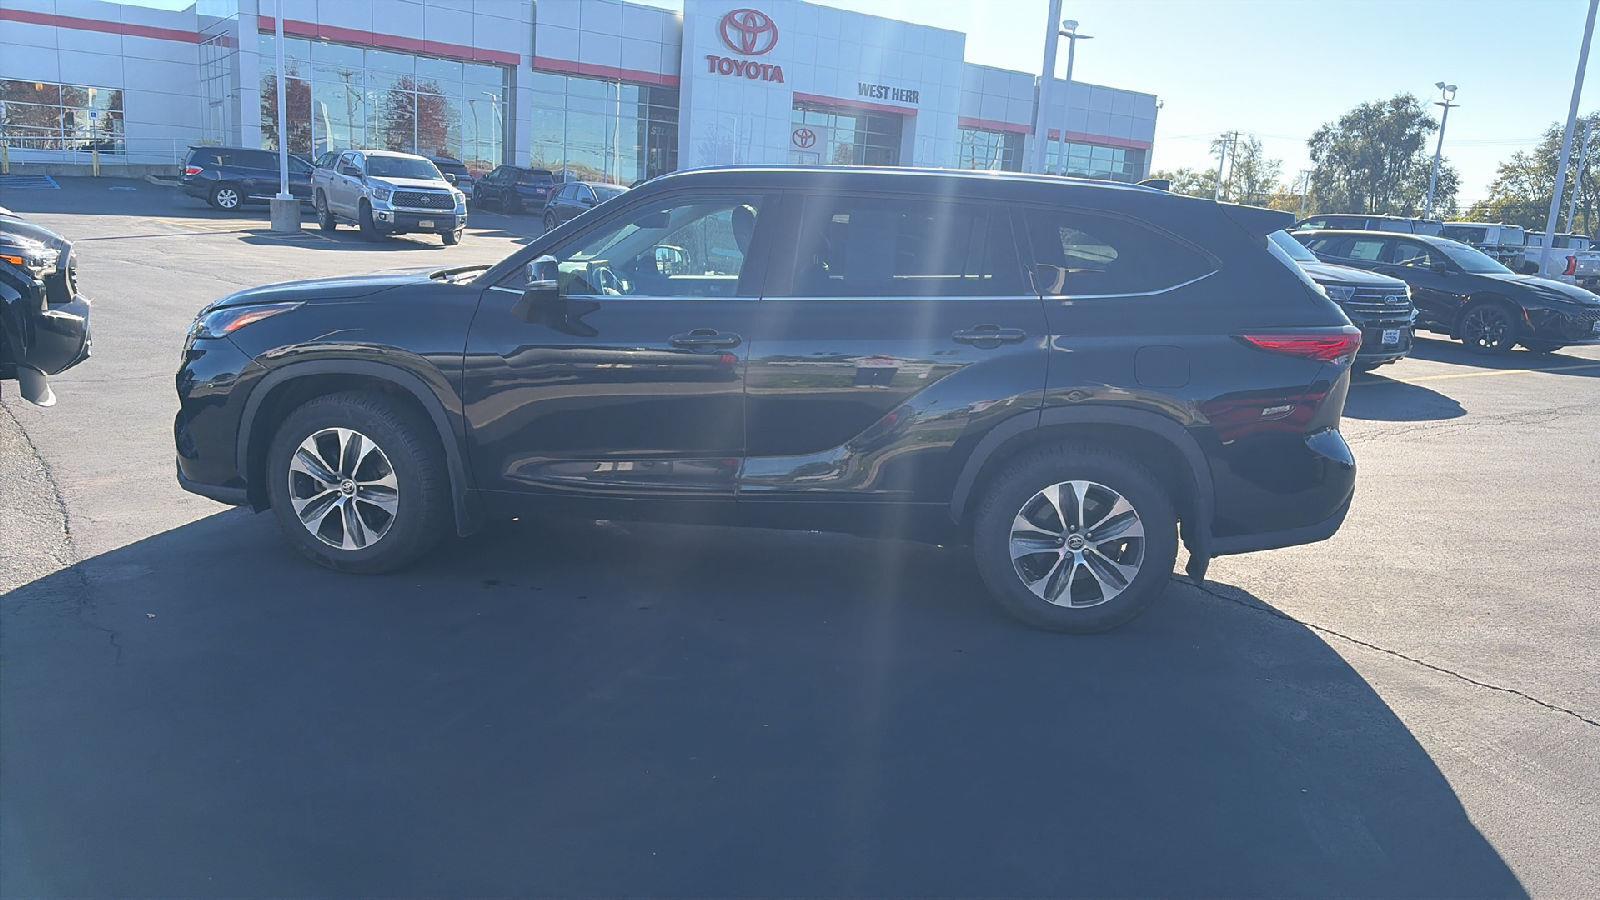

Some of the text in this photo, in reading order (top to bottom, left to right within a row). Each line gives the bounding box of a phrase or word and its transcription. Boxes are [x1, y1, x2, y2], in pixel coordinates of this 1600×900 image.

[705, 54, 784, 83] TOYOTA
[858, 82, 920, 104] WEST HERR
